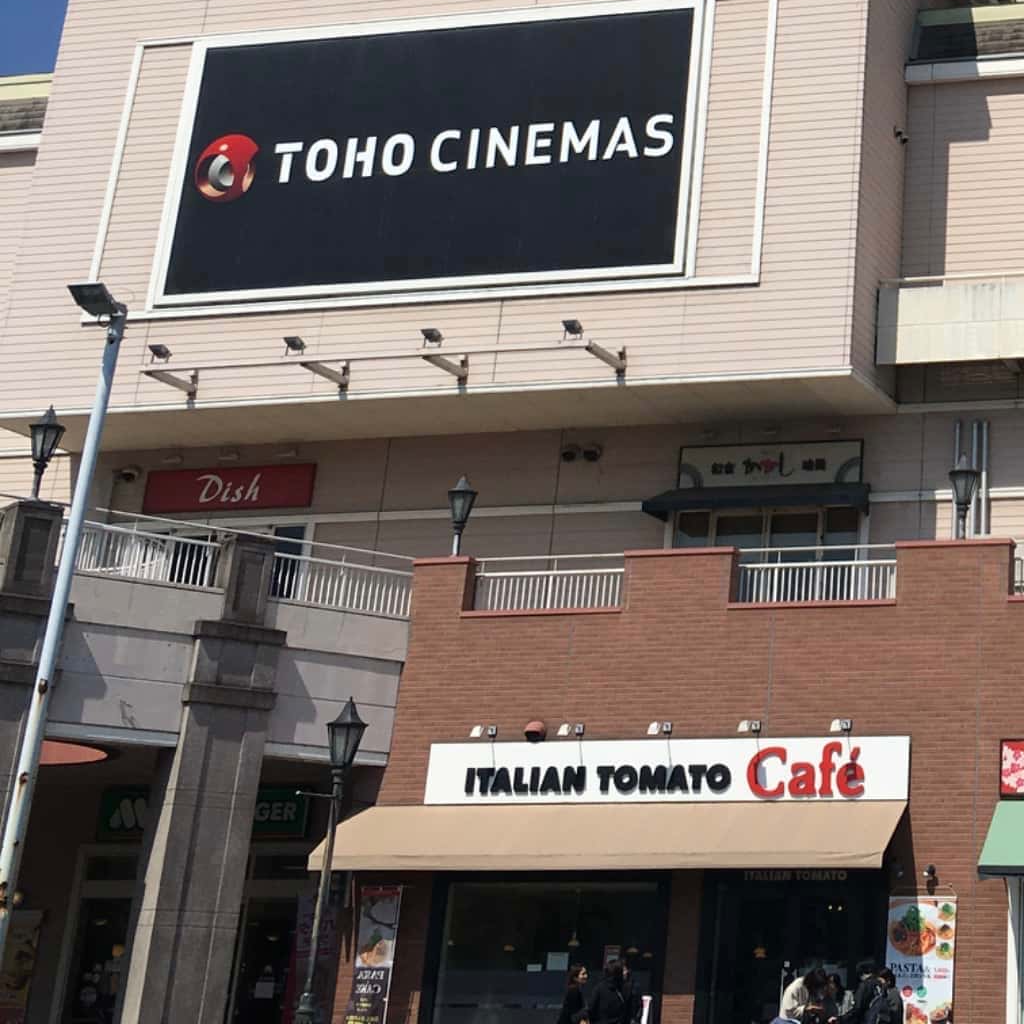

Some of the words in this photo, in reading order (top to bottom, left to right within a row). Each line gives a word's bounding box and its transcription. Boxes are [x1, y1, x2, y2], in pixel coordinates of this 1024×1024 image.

[273, 133, 414, 184] TOHO
[430, 113, 674, 173] CINEMAS
[195, 472, 261, 504] Dish
[464, 764, 586, 795] ITALIAN
[596, 762, 731, 794] TOMATO
[747, 741, 865, 799] Café
